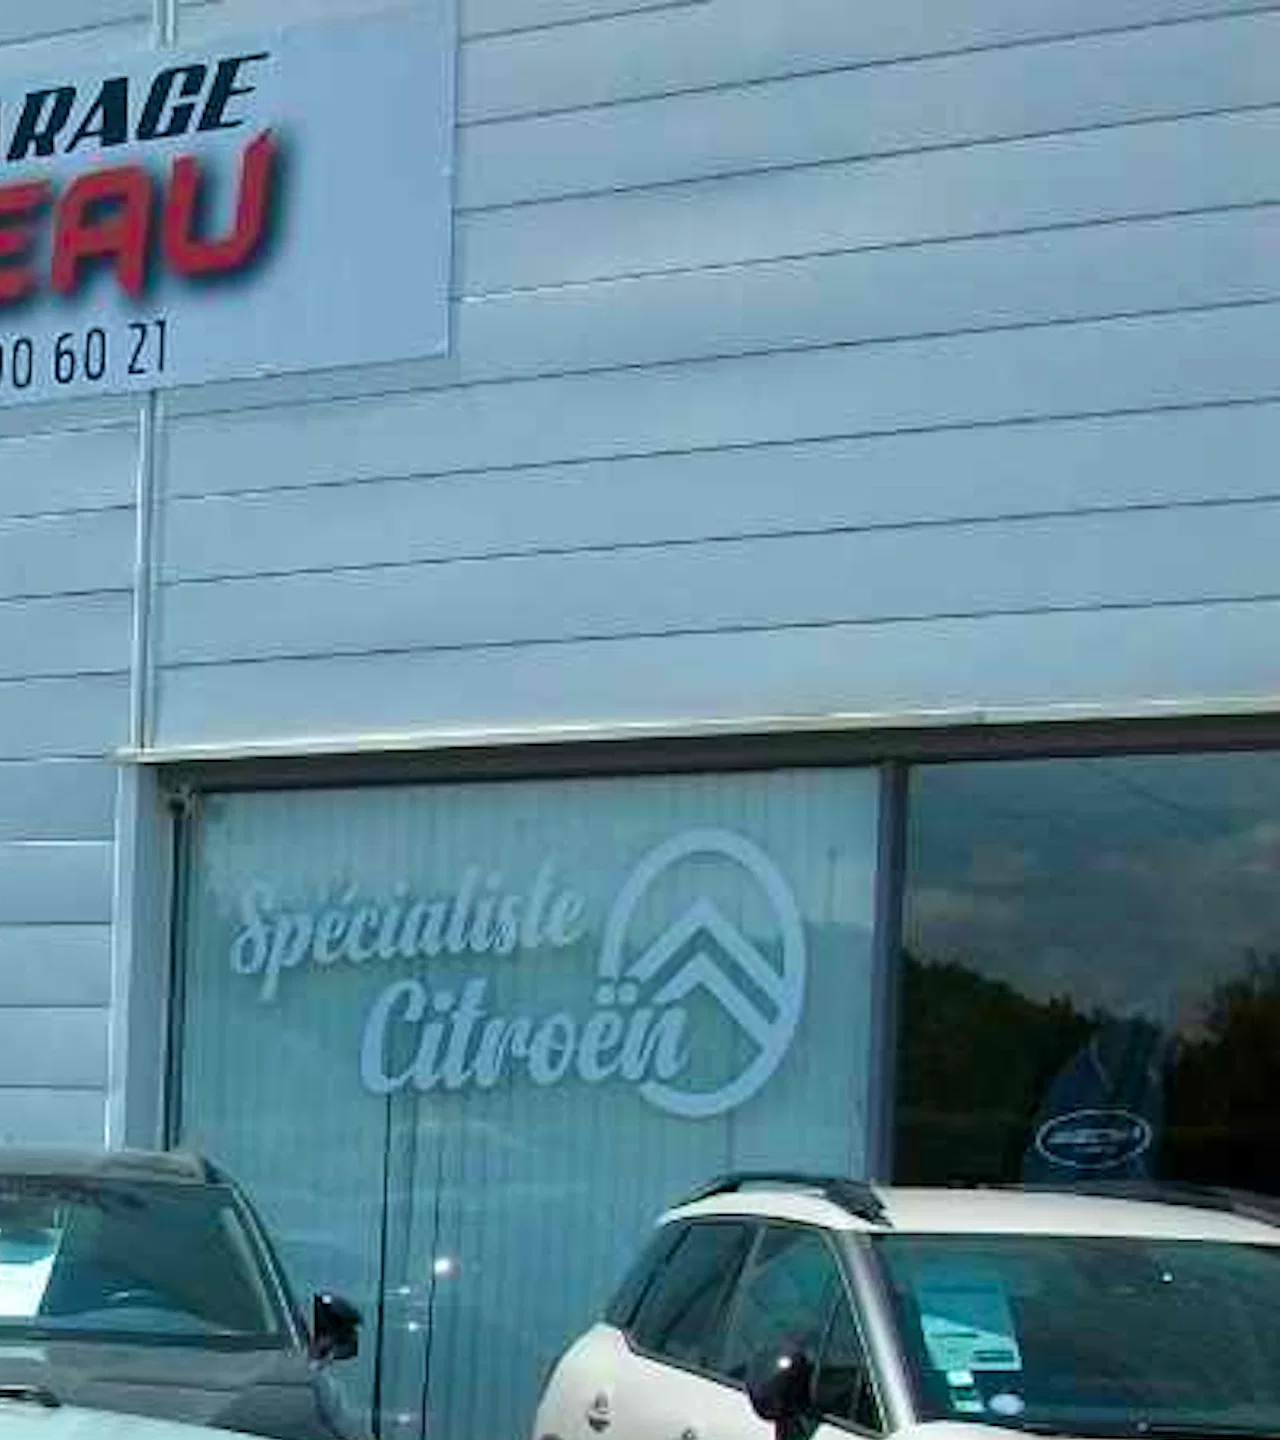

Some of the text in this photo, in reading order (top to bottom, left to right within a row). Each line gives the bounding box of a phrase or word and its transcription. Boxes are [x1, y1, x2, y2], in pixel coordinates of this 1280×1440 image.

[52, 327, 107, 383] 60
[126, 319, 168, 373] 21
[232, 864, 583, 998] Spécialiste
[361, 976, 690, 1095] Citroën
